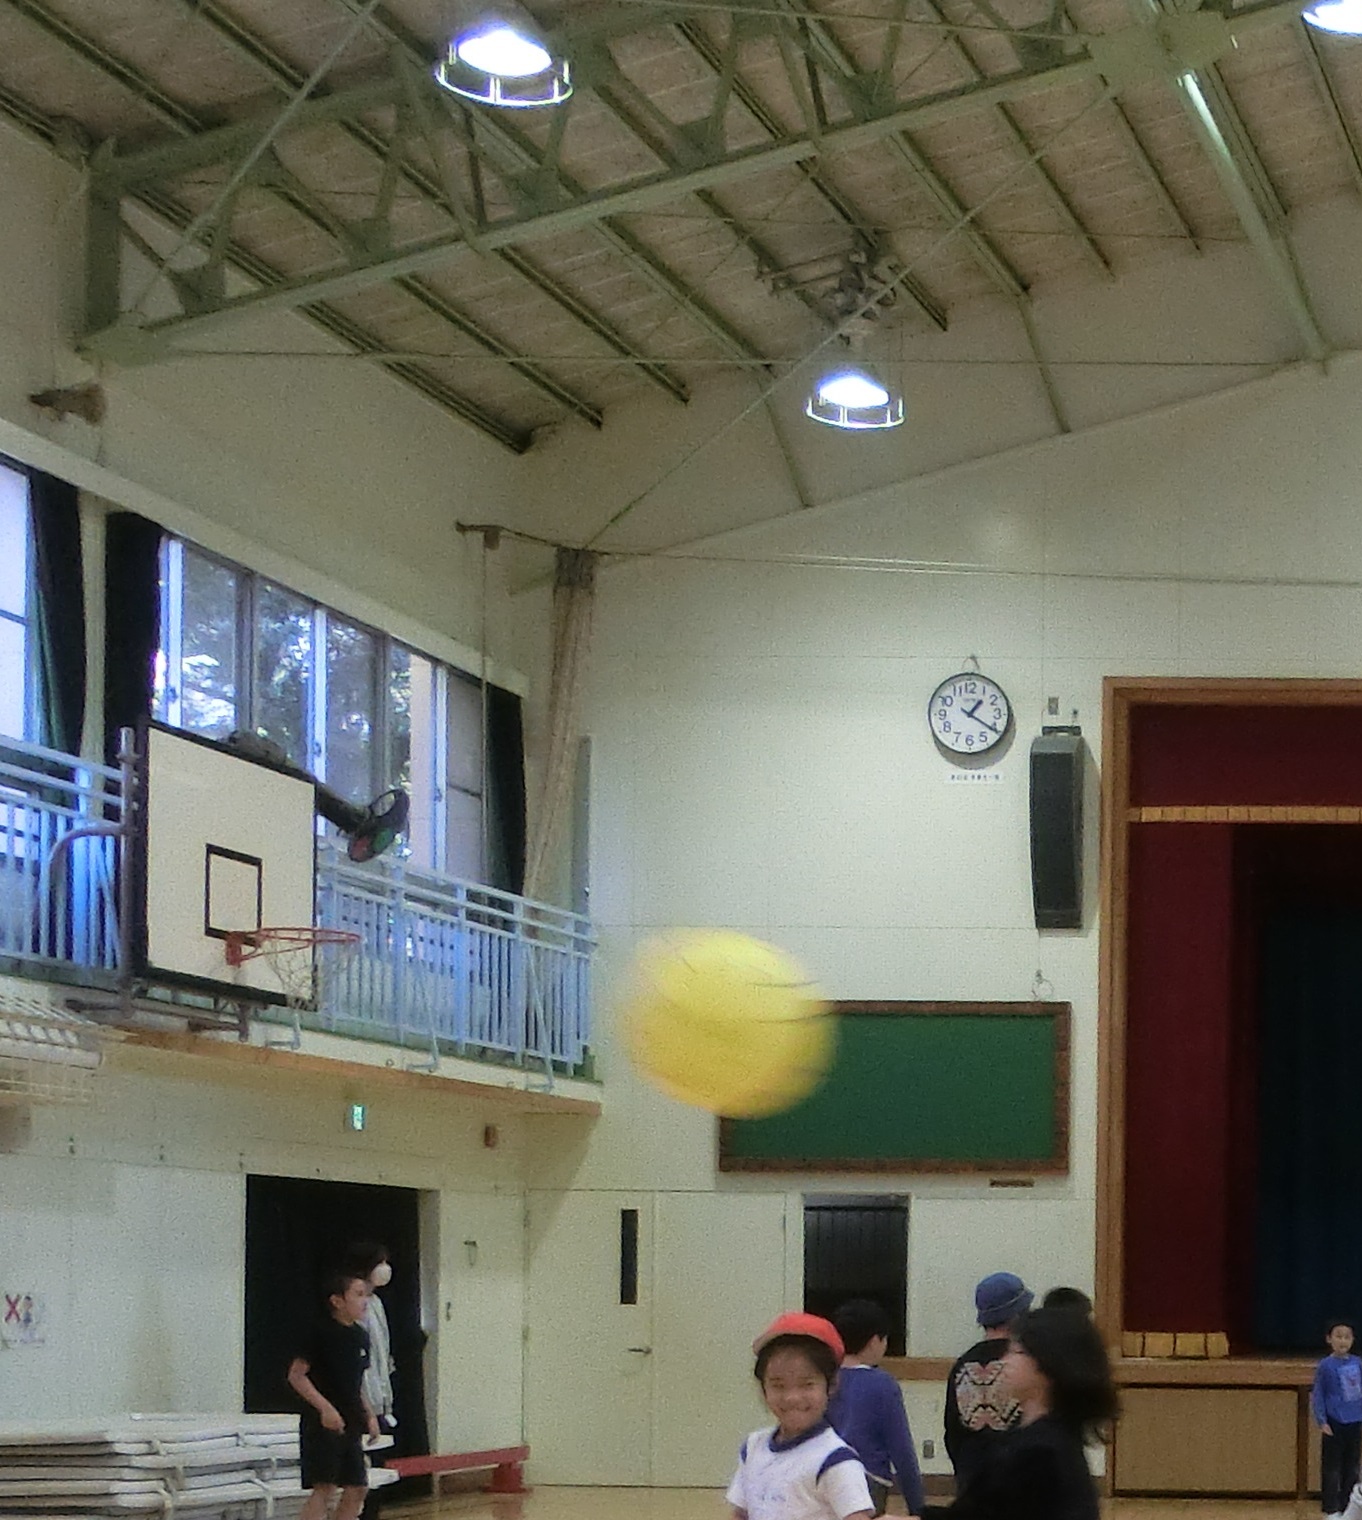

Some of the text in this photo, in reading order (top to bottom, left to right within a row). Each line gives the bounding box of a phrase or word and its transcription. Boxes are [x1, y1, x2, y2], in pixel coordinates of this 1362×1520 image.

[953, 685, 962, 696] 11
[965, 682, 977, 694] 12
[939, 696, 953, 707] 10
[990, 694, 998, 706] 2
[938, 709, 946, 720] 9
[994, 708, 1002, 720] 3
[943, 721, 952, 733] 8
[953, 731, 962, 743] 7
[965, 735, 974, 746] 6
[979, 731, 988, 742] 5
